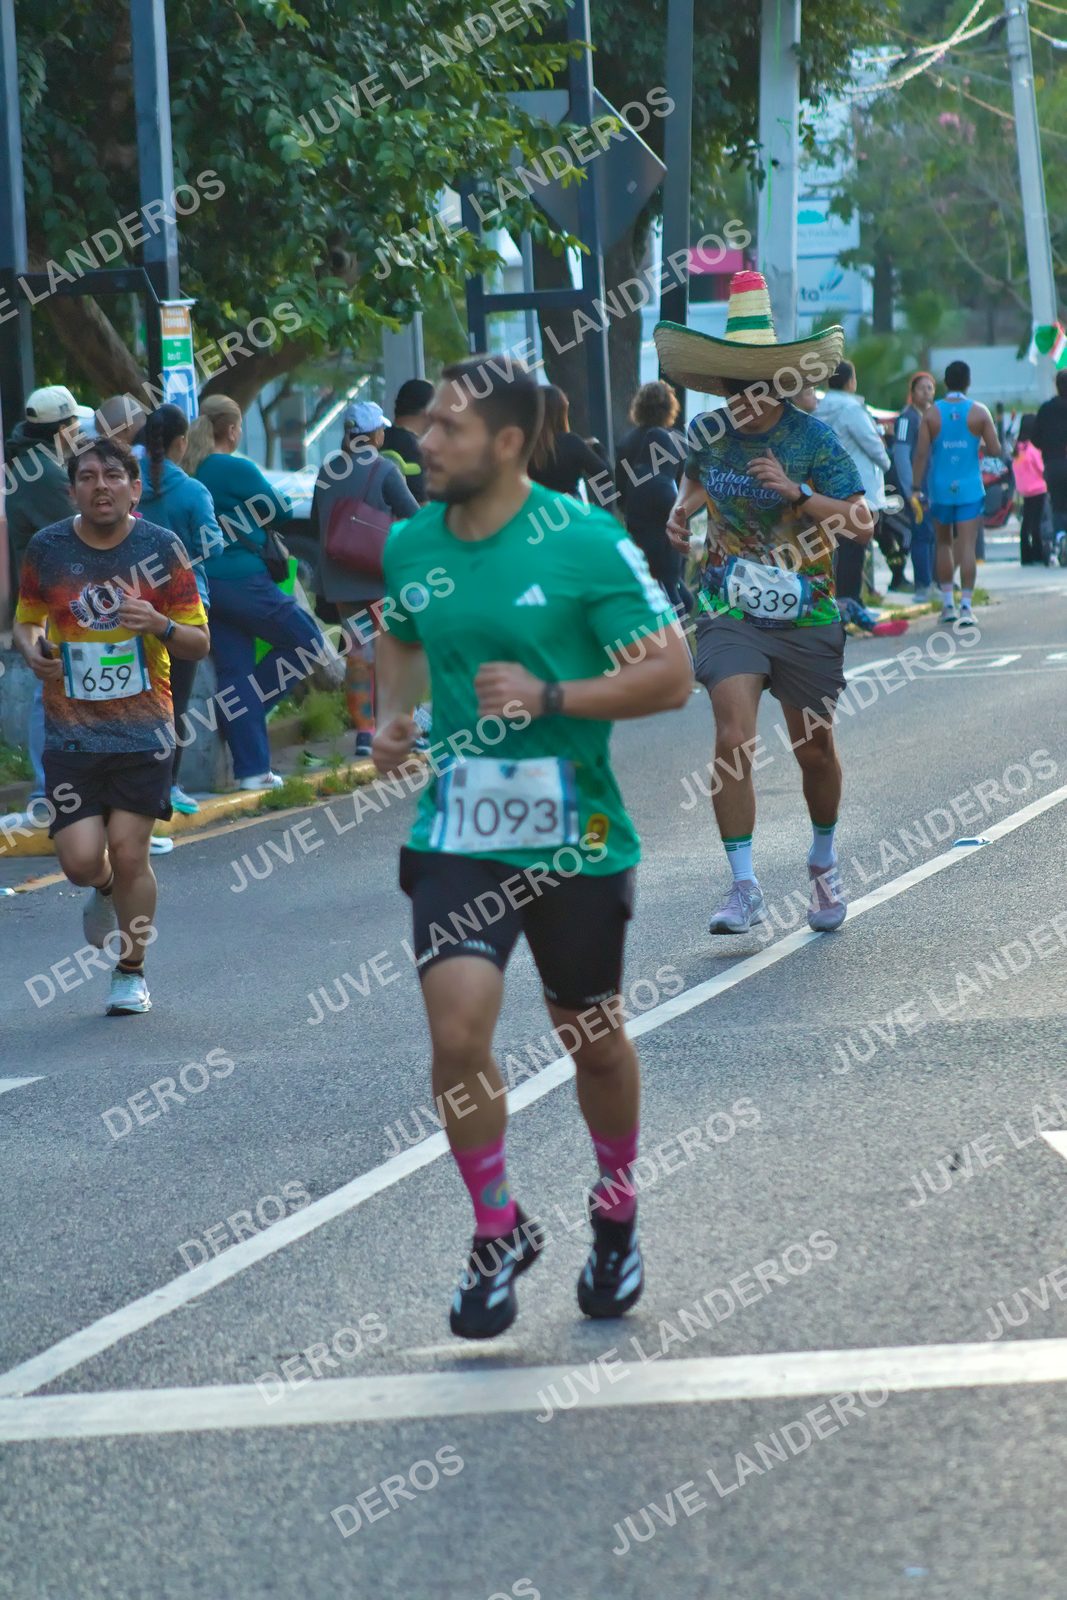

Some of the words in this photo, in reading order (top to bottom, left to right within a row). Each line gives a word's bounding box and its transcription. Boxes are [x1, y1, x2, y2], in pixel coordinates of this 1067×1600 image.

[707, 467, 754, 486] Sabor
[734, 583, 798, 614] 1339
[82, 665, 132, 692] 659
[455, 797, 558, 838] 1093
